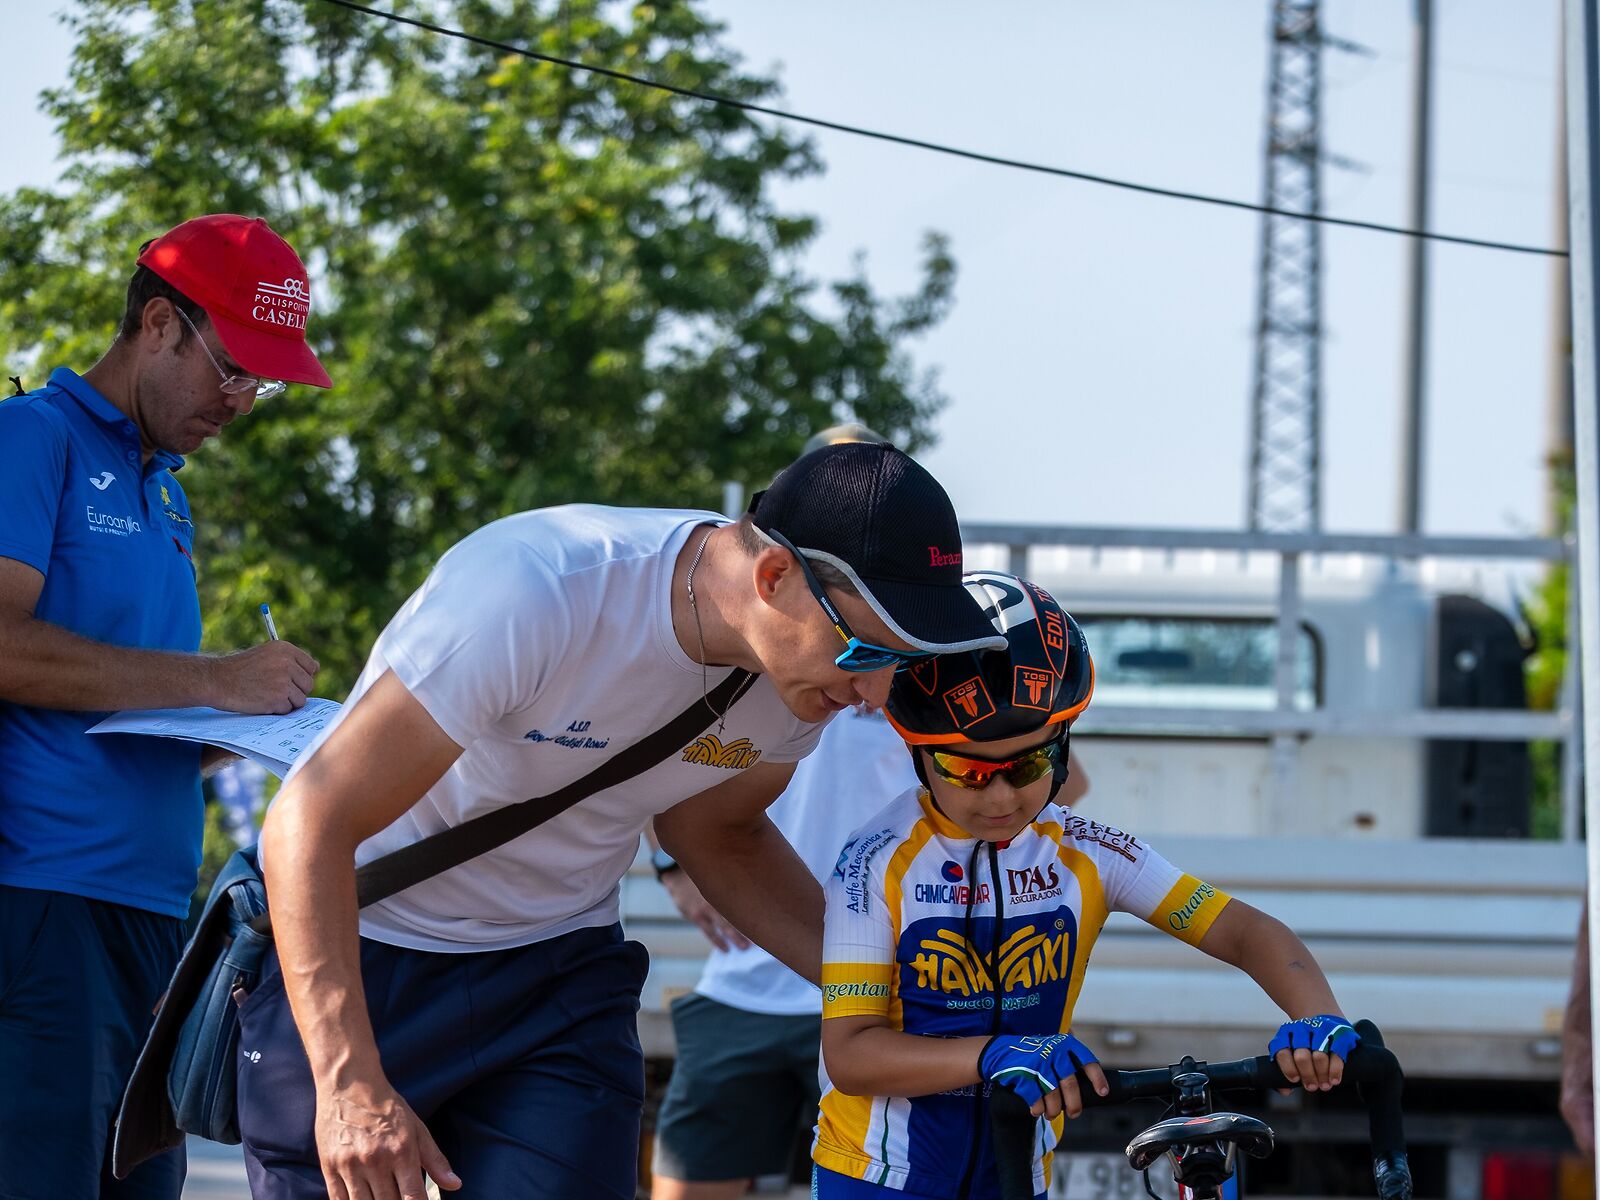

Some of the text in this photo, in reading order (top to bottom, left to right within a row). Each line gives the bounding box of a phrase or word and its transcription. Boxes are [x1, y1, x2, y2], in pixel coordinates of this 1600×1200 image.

[1045, 610, 1063, 651] EDIL
[1023, 671, 1049, 683] TOSI
[950, 682, 977, 701] TOSI
[1007, 863, 1060, 896] ITAS
